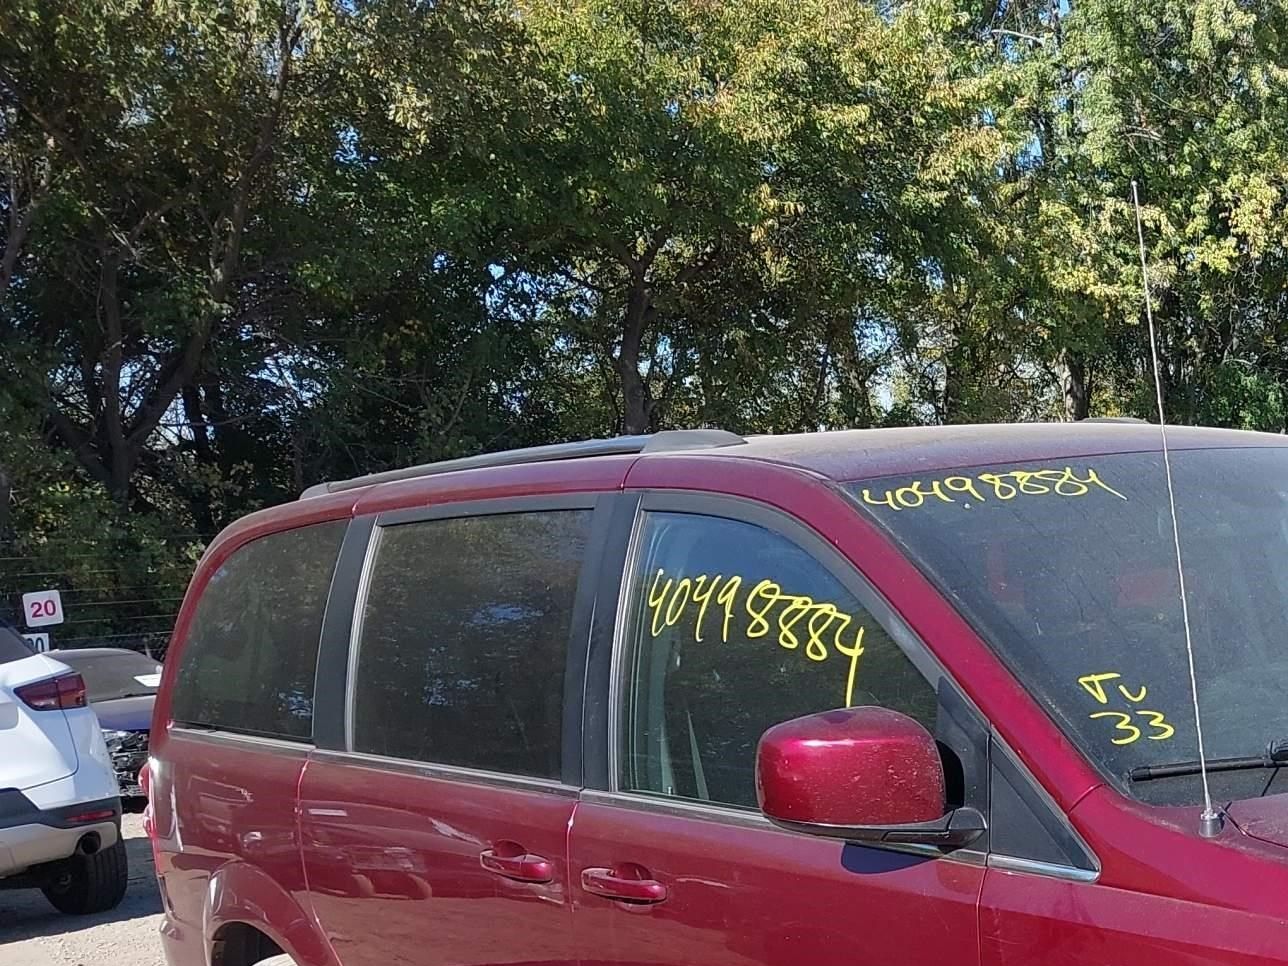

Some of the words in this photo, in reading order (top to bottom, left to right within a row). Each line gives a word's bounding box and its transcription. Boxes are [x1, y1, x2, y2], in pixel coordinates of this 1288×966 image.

[862, 467, 1128, 511] 40498884
[30, 599, 57, 619] 20
[649, 568, 865, 709] 40498884
[1089, 710, 1175, 745] 33
